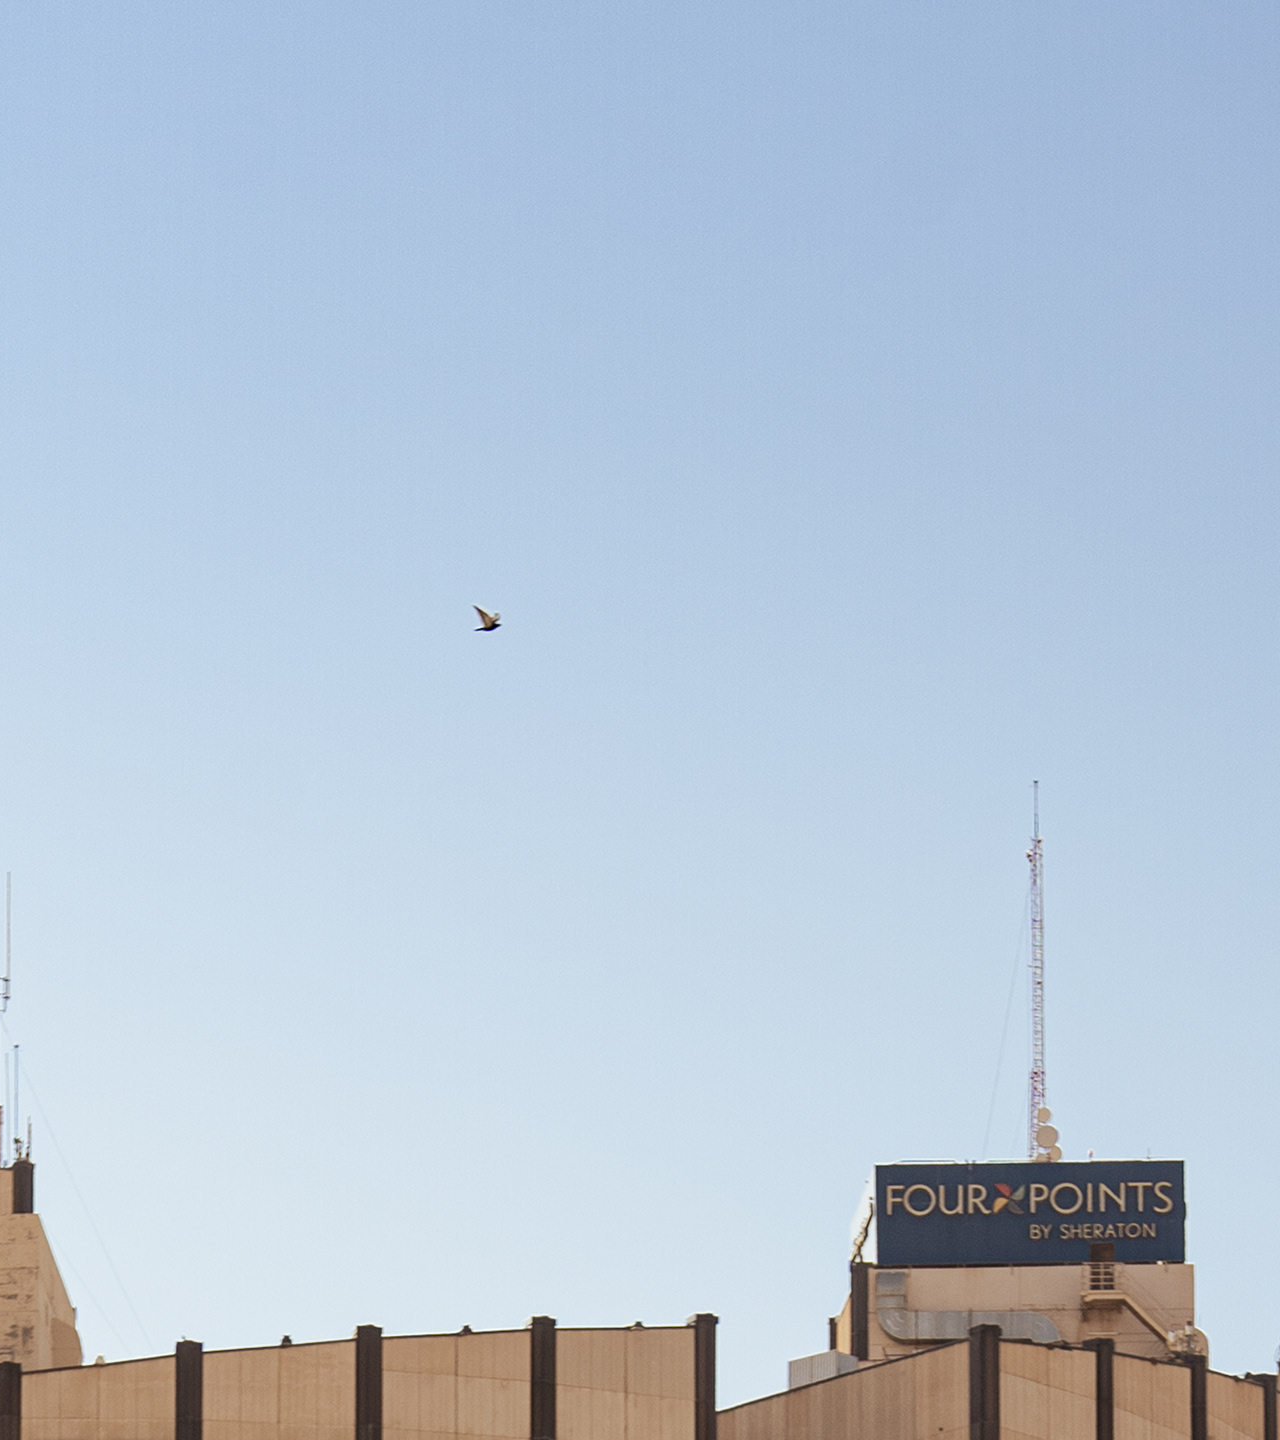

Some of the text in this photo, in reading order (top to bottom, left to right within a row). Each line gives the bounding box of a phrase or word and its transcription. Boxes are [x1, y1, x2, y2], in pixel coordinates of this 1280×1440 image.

[886, 1181, 1174, 1217] FOUR POINTS
[1029, 1222, 1157, 1240] BY SHERATON
